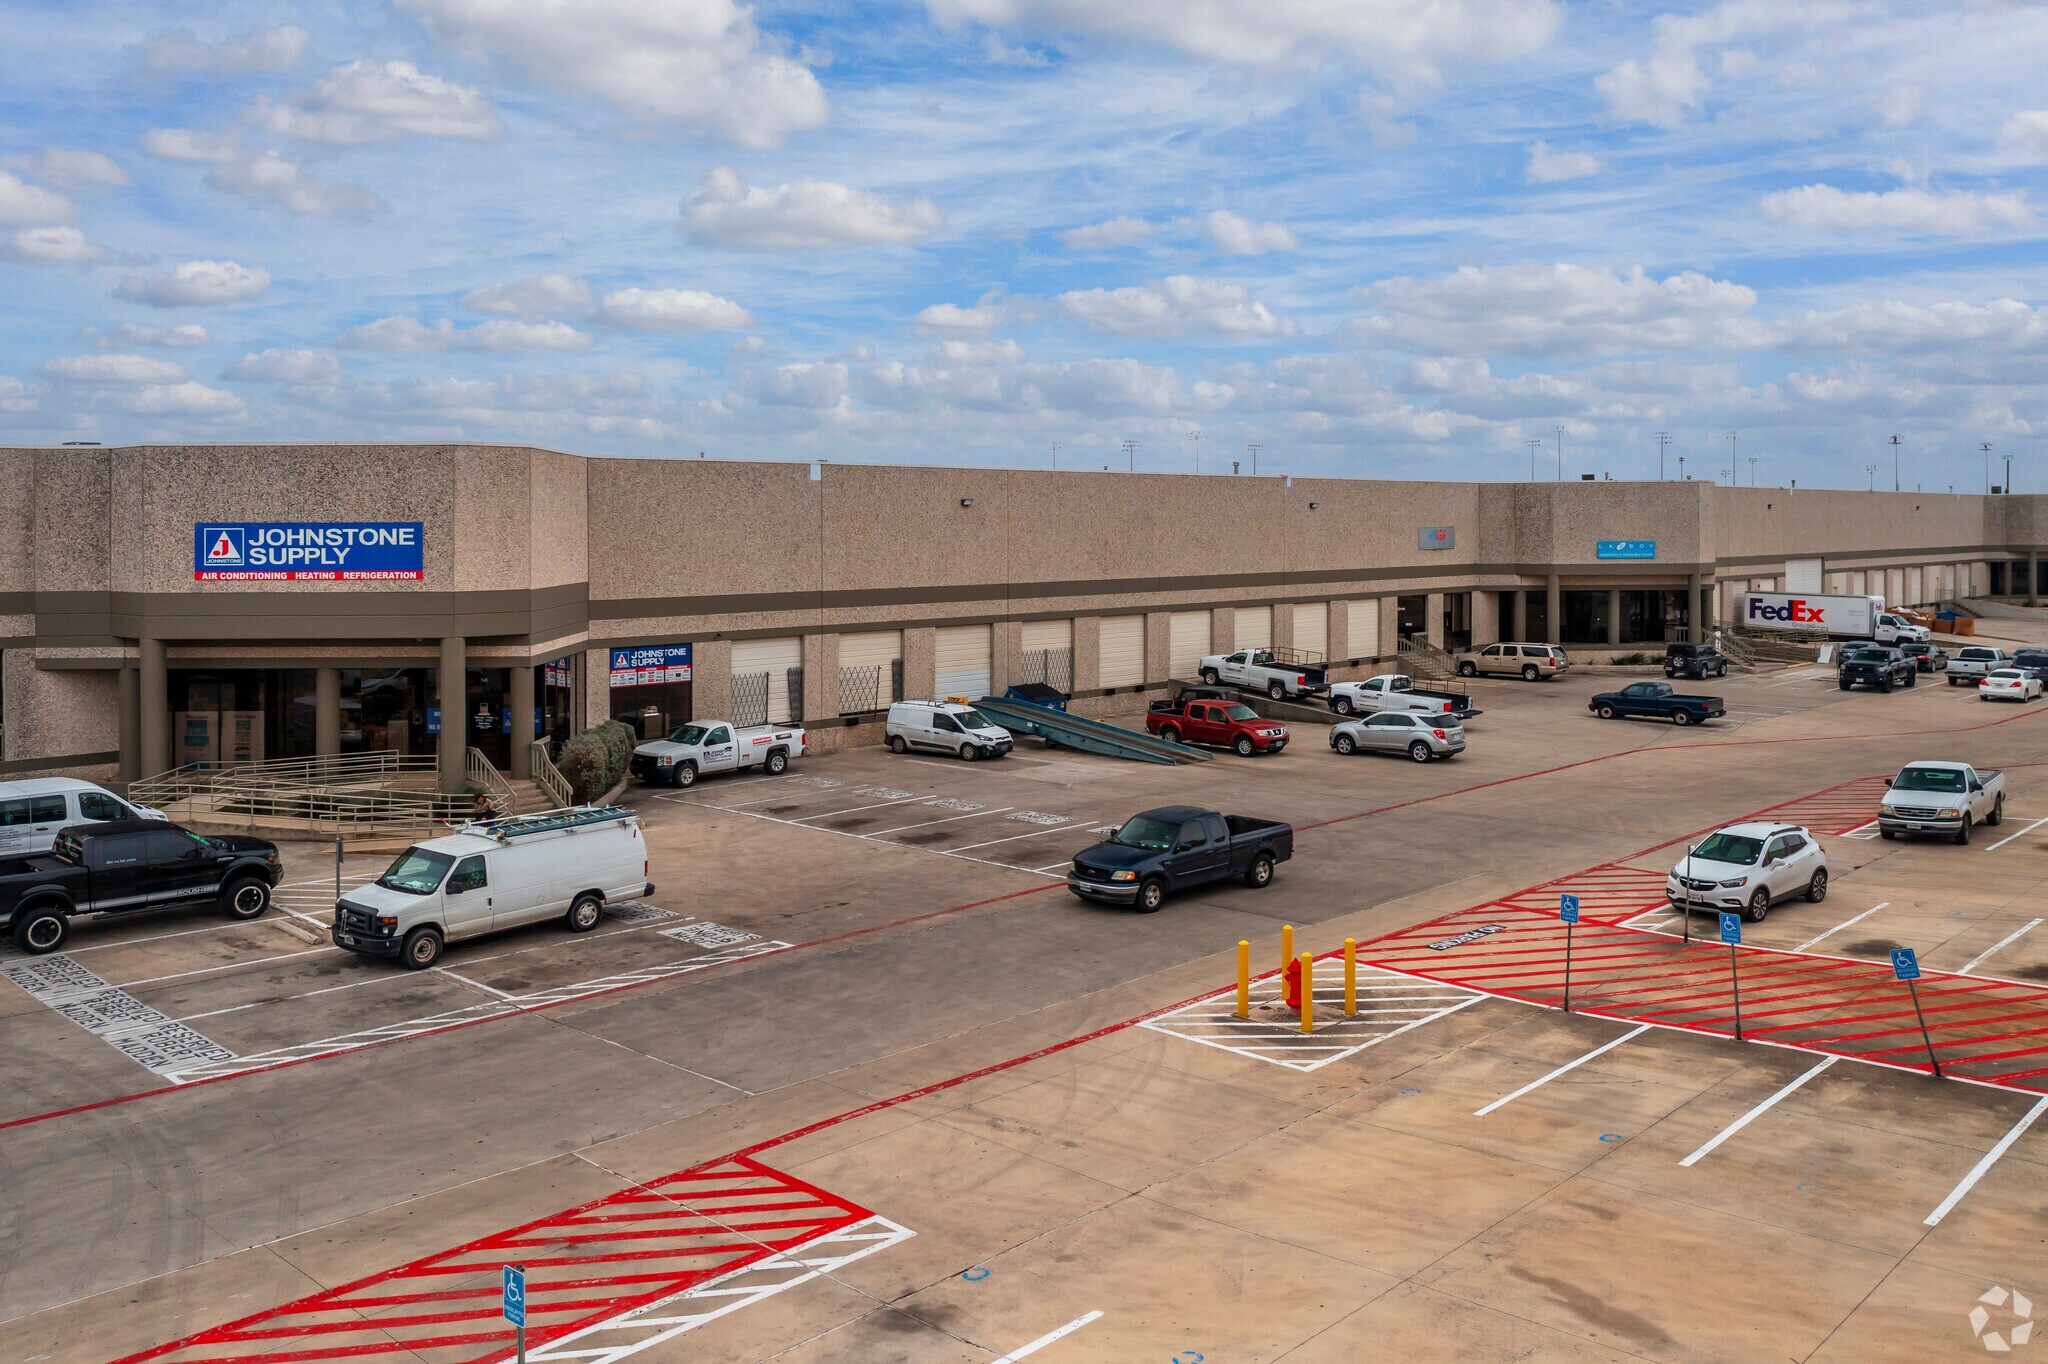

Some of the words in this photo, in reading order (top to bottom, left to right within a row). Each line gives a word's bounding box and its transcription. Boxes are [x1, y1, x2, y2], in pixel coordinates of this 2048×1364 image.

[249, 528, 415, 546] JOHNSTONE
[249, 547, 351, 565] SUPPLY
[201, 571, 218, 580] AIR
[219, 571, 288, 580] CONDITIONING
[295, 571, 336, 580] HEATING
[343, 571, 417, 579] REFRIGERATION
[1749, 598, 1826, 623] FedEx
[631, 647, 687, 659] JOHNSTONE
[631, 657, 665, 667] SUPPLY
[2, 967, 52, 994] MADDEN
[27, 963, 78, 988] ROBERT
[44, 955, 105, 989] RESERVED
[81, 997, 138, 1022] ROBERT
[97, 988, 166, 1024] RESERVED
[109, 1036, 173, 1068] MADDEN
[138, 1032, 201, 1061] ROBERT
[156, 1022, 234, 1062] RESERVED
